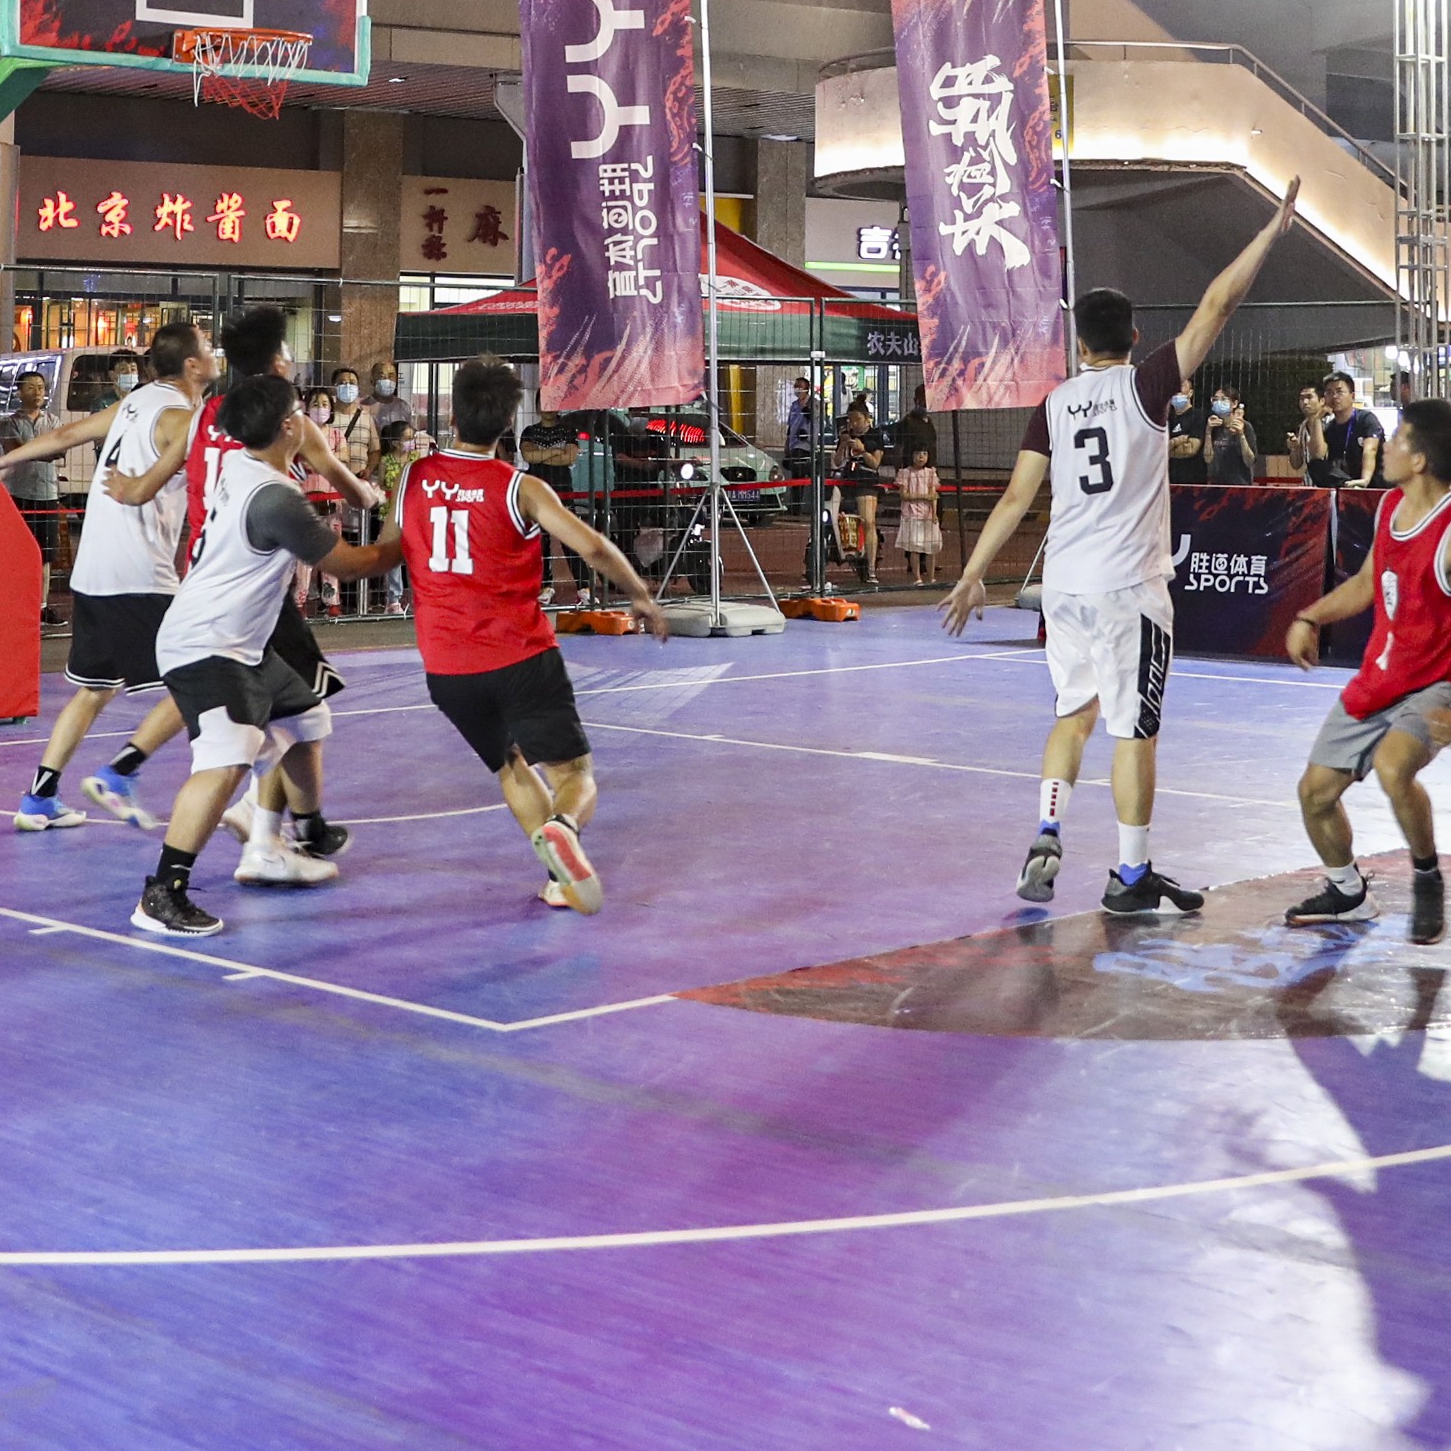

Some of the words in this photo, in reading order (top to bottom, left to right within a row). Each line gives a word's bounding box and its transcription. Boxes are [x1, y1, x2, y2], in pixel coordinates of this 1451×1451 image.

[38, 191, 302, 243] 北京炸酱面
[1074, 426, 1114, 495] 3
[429, 506, 473, 575] 11
[1190, 552, 1267, 576] 胜道体育
